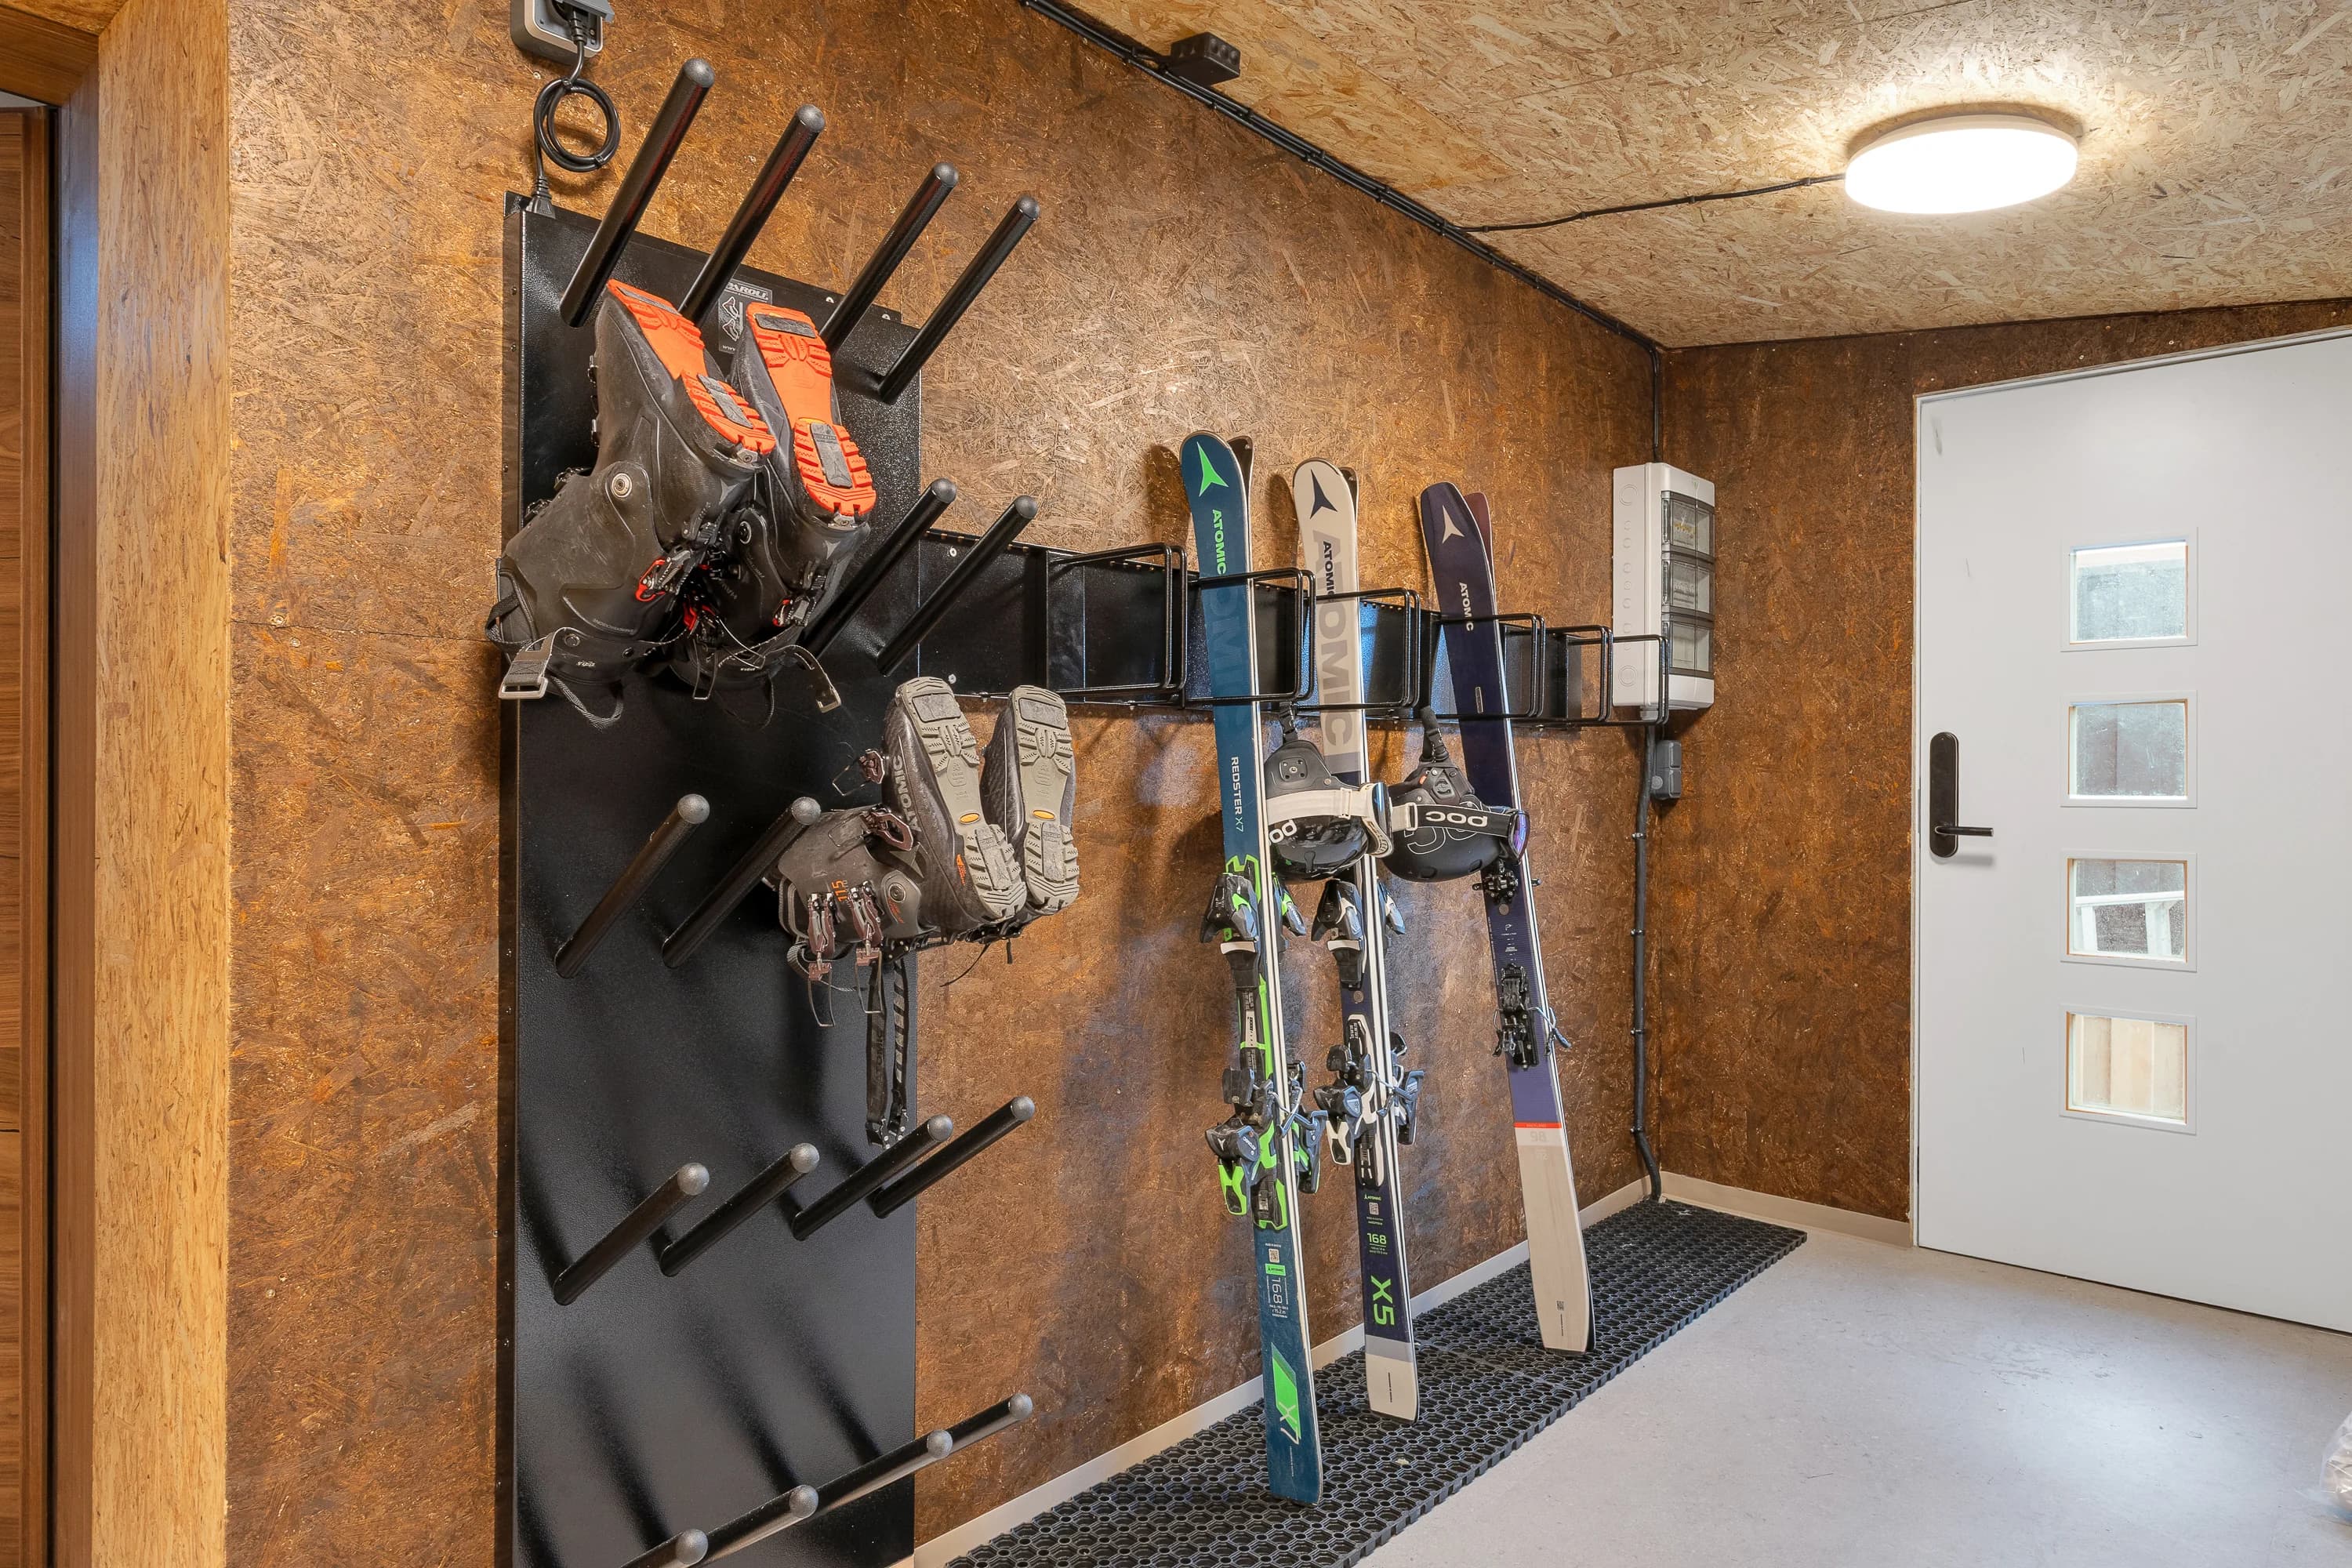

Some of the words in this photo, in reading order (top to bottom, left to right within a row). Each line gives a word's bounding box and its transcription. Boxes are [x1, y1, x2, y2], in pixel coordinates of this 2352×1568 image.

[1212, 508, 1227, 575] ATOMIC
[1459, 582, 1474, 631] ATOMC
[892, 754, 922, 833] ATOMIC
[1231, 756, 1243, 815] REDSTER
[1235, 816, 1244, 833] X7
[1367, 1232, 1387, 1245] 168
[1272, 1276, 1283, 1304] 168
[1370, 1275, 1396, 1326] X5
[1279, 1401, 1300, 1445] X7
